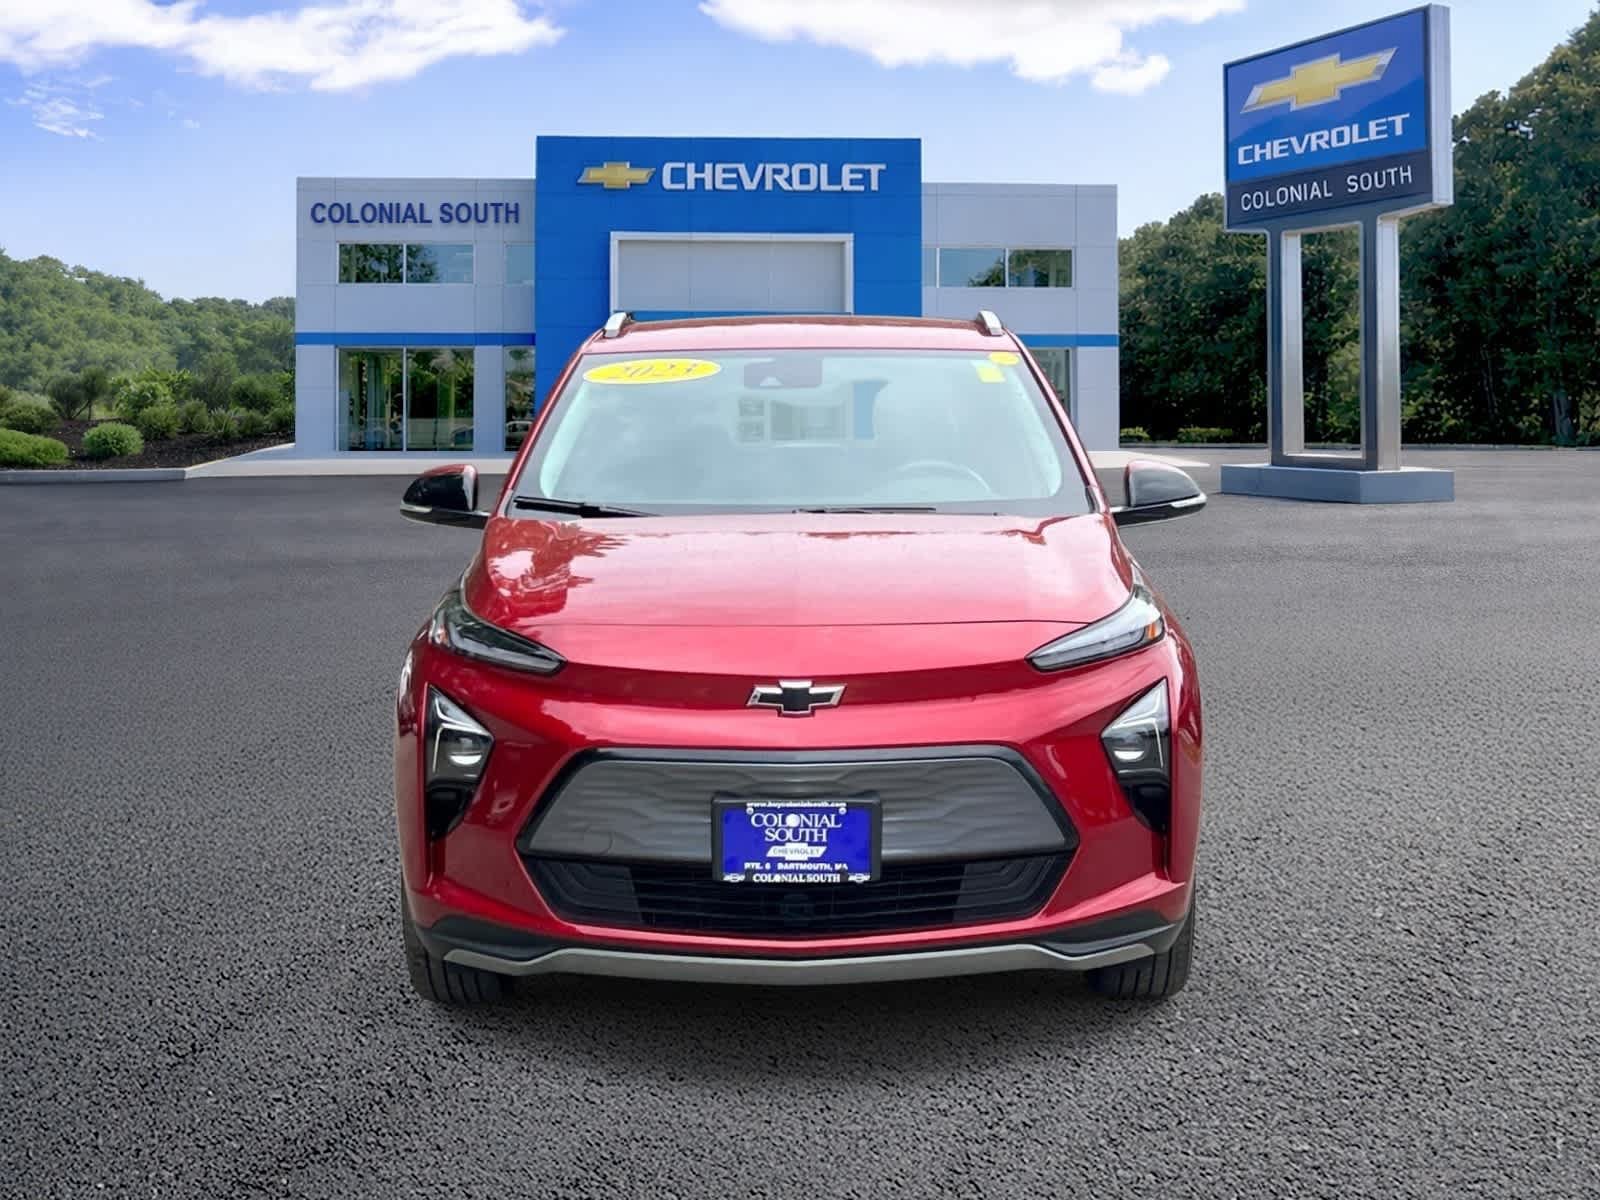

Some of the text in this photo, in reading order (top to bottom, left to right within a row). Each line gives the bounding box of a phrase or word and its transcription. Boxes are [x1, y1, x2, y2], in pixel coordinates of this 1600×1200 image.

[1237, 113, 1410, 165] CHEVROLET
[661, 161, 887, 192] CHEVROLET
[1240, 165, 1412, 211] COLONIAL SOUTH
[310, 202, 520, 224] COLONIAL SOUTH
[750, 812, 842, 828] COLONIAL
[764, 827, 828, 842] SOUTH
[772, 846, 821, 855] CHEVROLET
[777, 862, 833, 871] DARTMOUTH,
[752, 873, 841, 883] COLONIAL SOUTH
